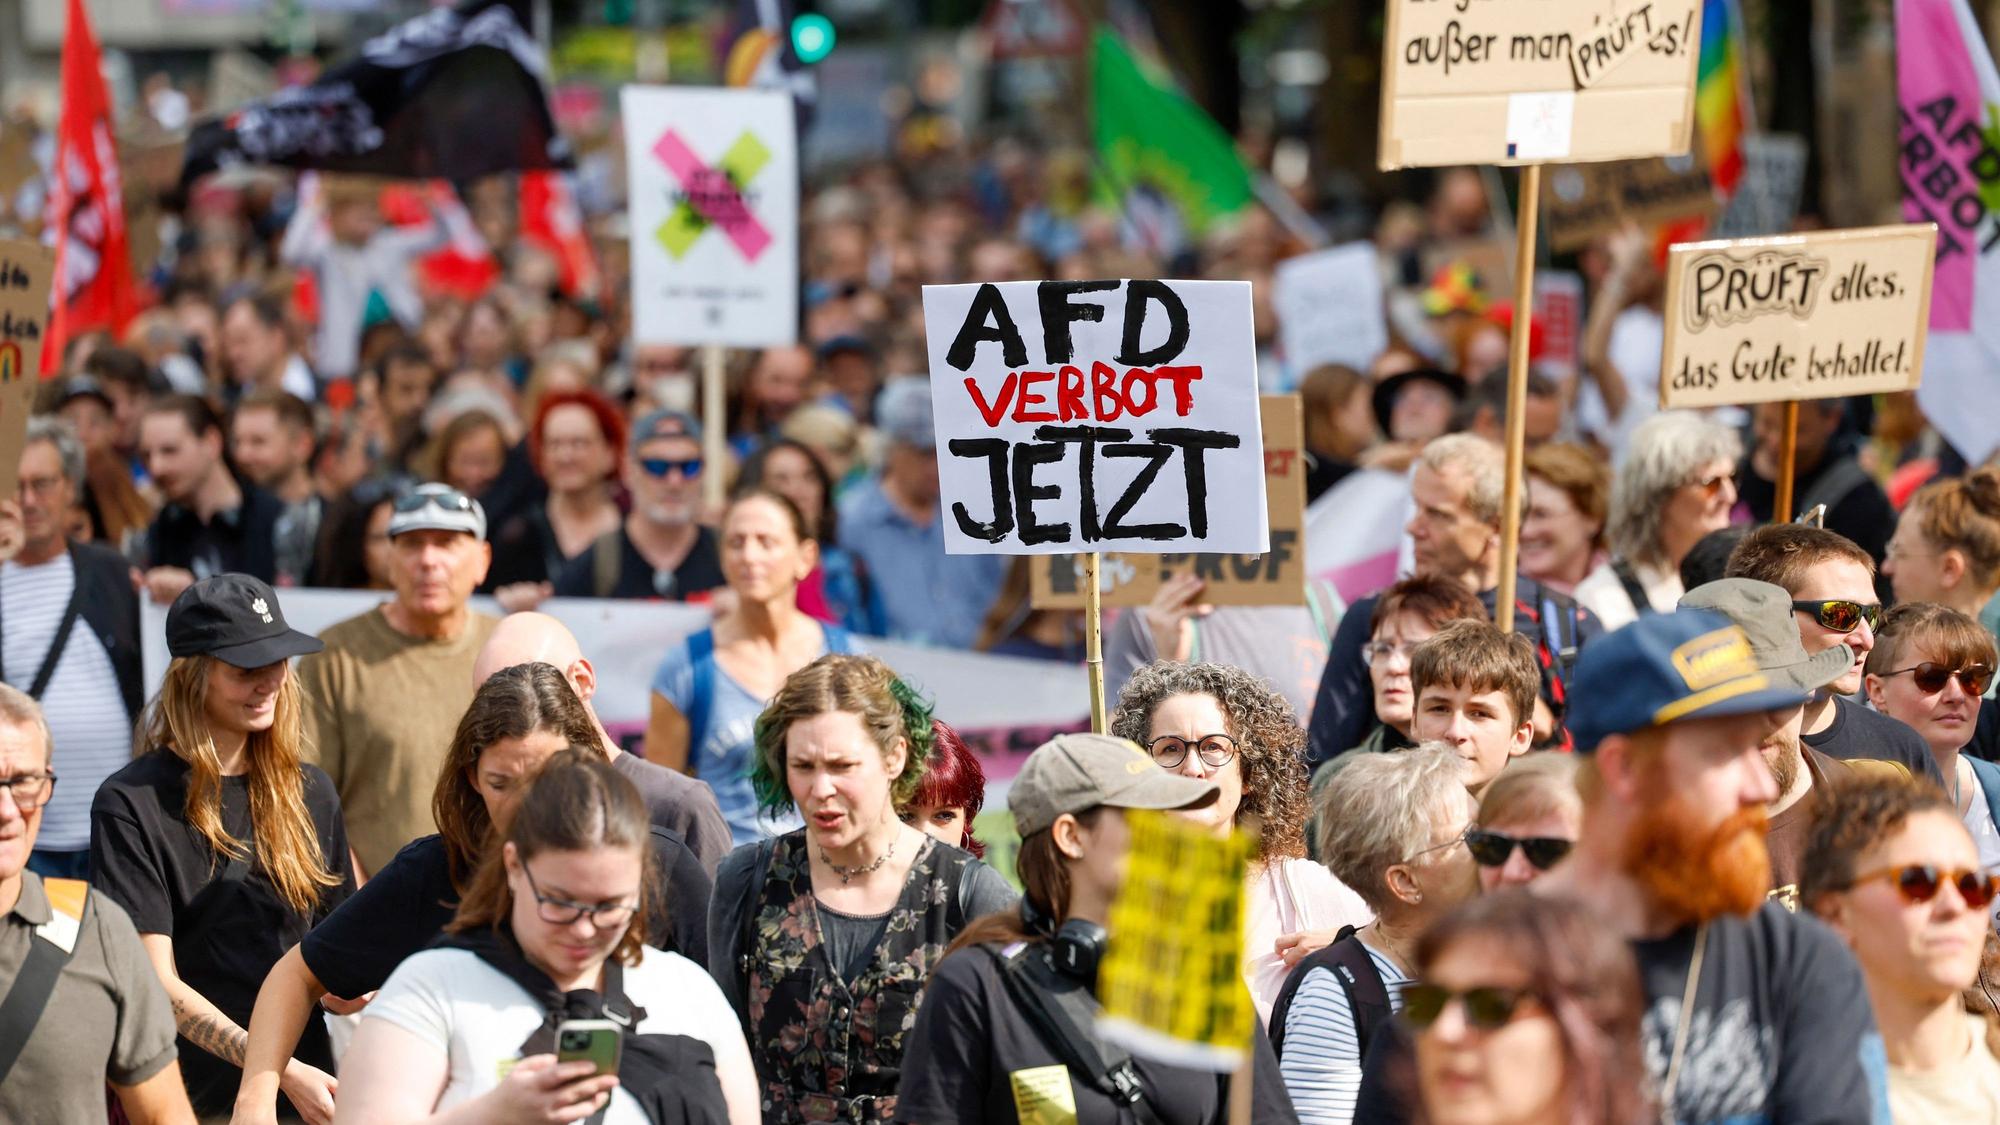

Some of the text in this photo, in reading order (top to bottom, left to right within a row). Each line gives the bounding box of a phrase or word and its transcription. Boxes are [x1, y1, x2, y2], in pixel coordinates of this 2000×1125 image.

[1405, 20, 1498, 75] außer
[1510, 32, 1572, 60] man
[1578, 4, 1653, 79] PRÜFT
[1696, 257, 1819, 317] PRÜFT
[945, 279, 1191, 372] AFD
[963, 361, 1203, 428] VERBOT
[1672, 355, 1719, 390] das
[1731, 340, 1796, 383] Gute
[948, 425, 1241, 546] JETZT
